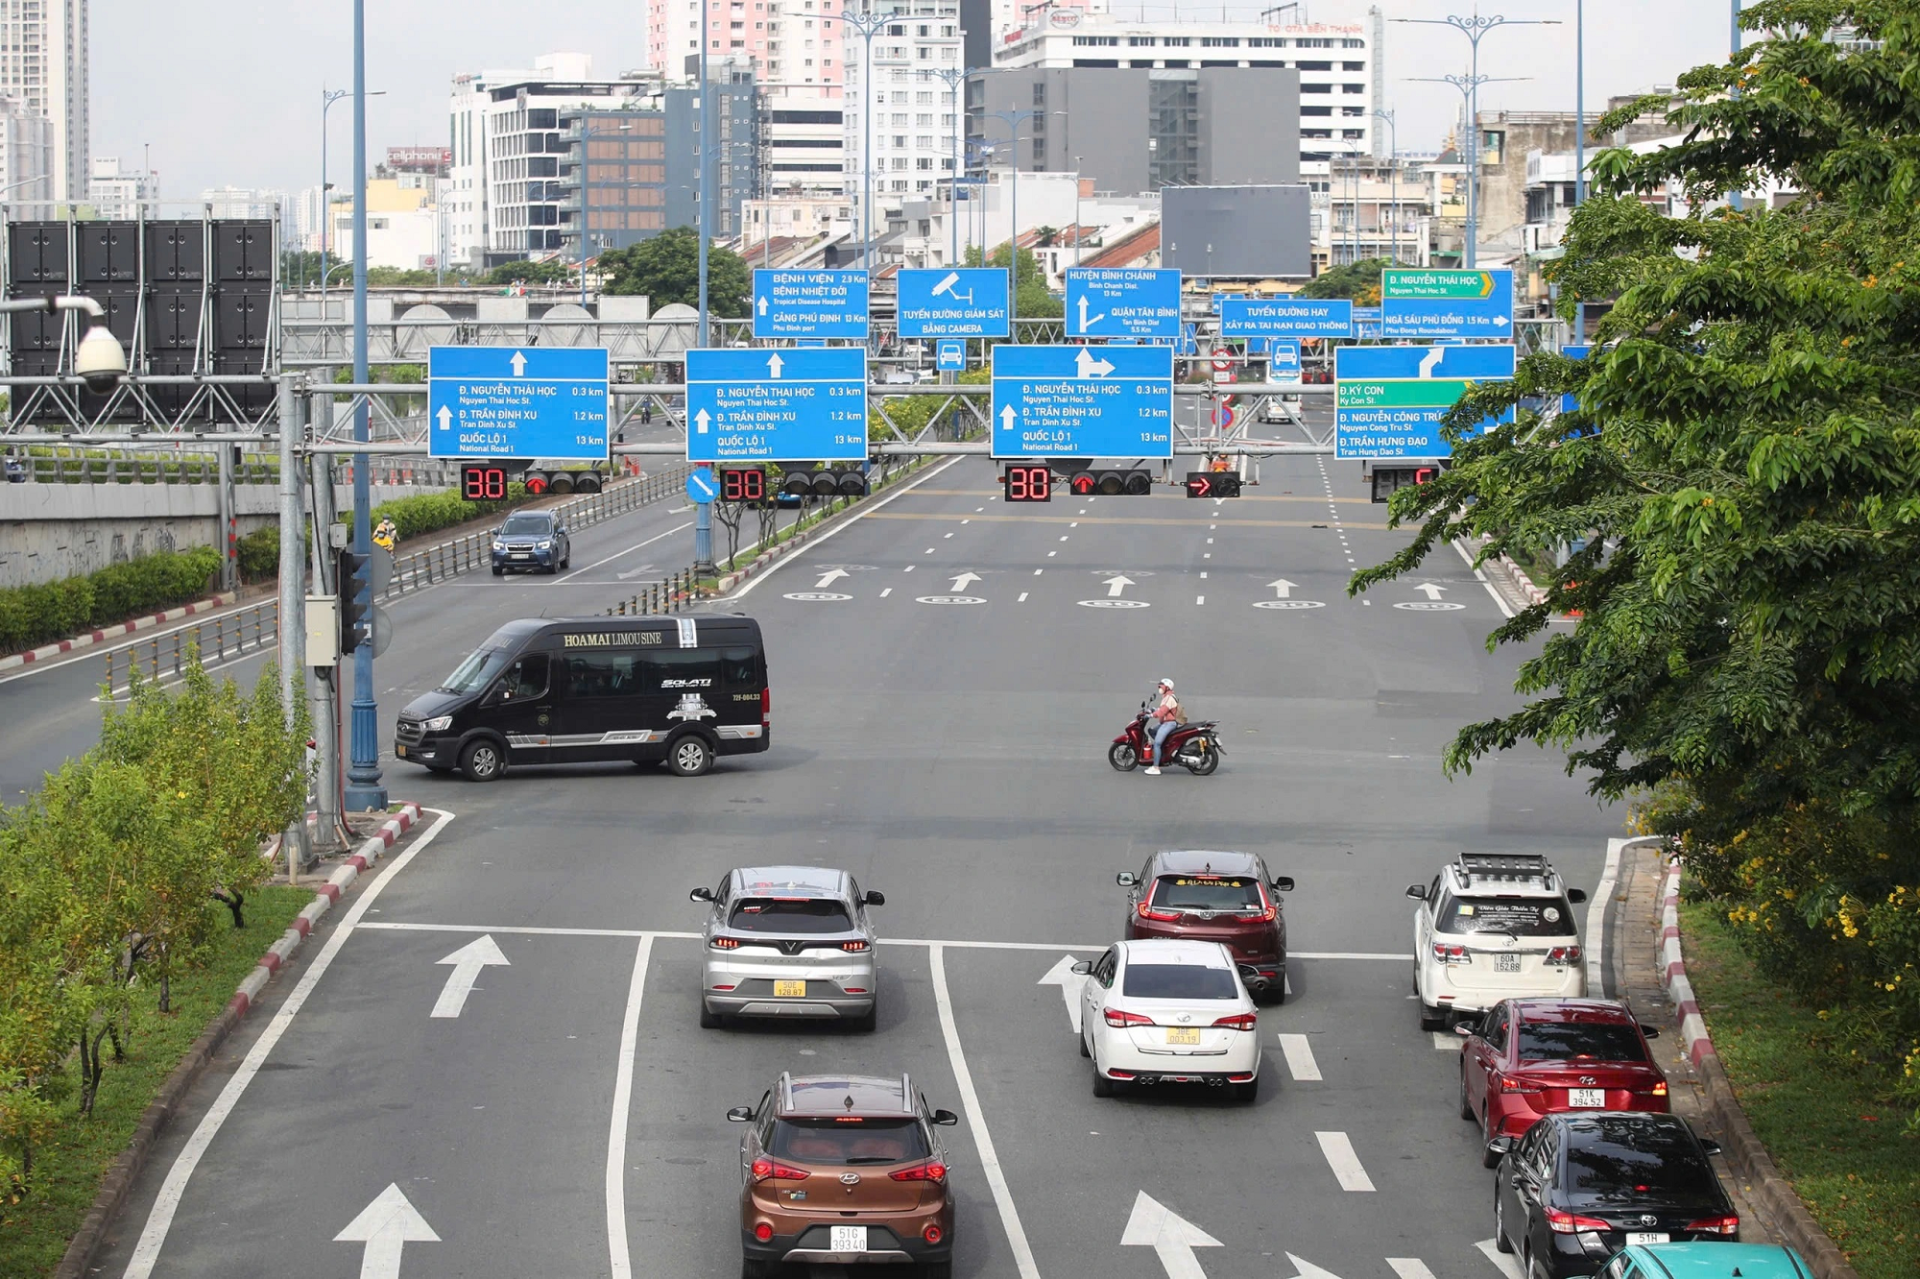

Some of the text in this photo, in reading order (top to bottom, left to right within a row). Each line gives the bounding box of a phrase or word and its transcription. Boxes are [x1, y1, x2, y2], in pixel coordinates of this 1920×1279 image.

[773, 273, 805, 284] BỆNH
[808, 273, 834, 284] VIỆN
[854, 275, 866, 283] Km
[1070, 269, 1156, 281] HUYỆN BÌNH CHÁNH
[1390, 273, 1477, 285] Đ. NGUYỄN THÁI HỌC
[773, 285, 847, 296] BỆNH NHIỆT ĐỚI
[903, 308, 1004, 319] TUYẾN ĐƯỜNG GIÁM SÁT
[1111, 307, 1178, 317] QUẬN TÂN BÌNH
[1247, 305, 1328, 316] TUYẾN ĐƯỜNG HAY
[773, 312, 797, 322] CẢNG
[799, 312, 817, 322] PHÚ
[819, 314, 840, 323] ĐỊNH
[1385, 315, 1403, 324] NGÃ
[1404, 314, 1421, 324] SÁU
[1422, 314, 1440, 324] PHÙ
[1441, 313, 1464, 324] ĐỔNG
[1467, 316, 1476, 324] 1.5
[922, 322, 982, 333] BẰNG CAMERA
[1318, 321, 1348, 329] THÔNG
[459, 383, 603, 397] Đ. NGUYỄN THÁI HỌC 0.3 km
[717, 389, 726, 397] Đ.
[729, 385, 768, 397] NGUYỄN
[795, 388, 814, 398] HỌC
[830, 387, 843, 396] 0.3
[846, 387, 861, 395] km
[1023, 382, 1167, 395] Đ. NGUYỄN THÁI HỌC 0.3 km
[1339, 385, 1384, 395] Đ.KÝ CON
[460, 397, 487, 405] Nguyen
[1339, 398, 1349, 406] Ky
[459, 408, 603, 420] Đ. TRẦN ĐÌNH XU 1.2 km
[717, 410, 861, 422] Đ. TRẦN ĐÌNH XU 1.2 km
[1022, 405, 1167, 417] Đ. TRẦN ĐÌNH XU 1.2 km
[1340, 414, 1350, 422] Đ.
[1352, 410, 1391, 422] NGUYỄN
[1394, 411, 1420, 421] CÔNG
[1340, 424, 1368, 432] Nguyen
[1369, 424, 1388, 432] Cong
[460, 432, 603, 446] QUỐC LỘ 1 13 km
[718, 434, 861, 448] QUỐC LỘ 1 13 km
[1023, 429, 1049, 441] QUỐC
[1052, 430, 1064, 444] LỘ
[1141, 433, 1150, 441] 13
[1153, 433, 1167, 441] km
[1377, 437, 1405, 446] HƯNG
[1407, 437, 1427, 447] ĐẠO
[1359, 449, 1379, 457] Hung
[467, 469, 504, 499] 30
[727, 470, 762, 500] 30
[1011, 469, 1048, 499] 30
[563, 632, 662, 647] HOAMAI LIMOUSINE
[1500, 954, 1514, 963] 60A
[1495, 962, 1520, 971] 152.88
[782, 981, 797, 990] 50E
[777, 988, 803, 997] 128.87
[1578, 1089, 1595, 1098] 51K
[1573, 1098, 1601, 1107] 394.52
[839, 1227, 859, 1240] 51G
[1639, 1233, 1658, 1243] 51H
[832, 1239, 866, 1251] 393.40
